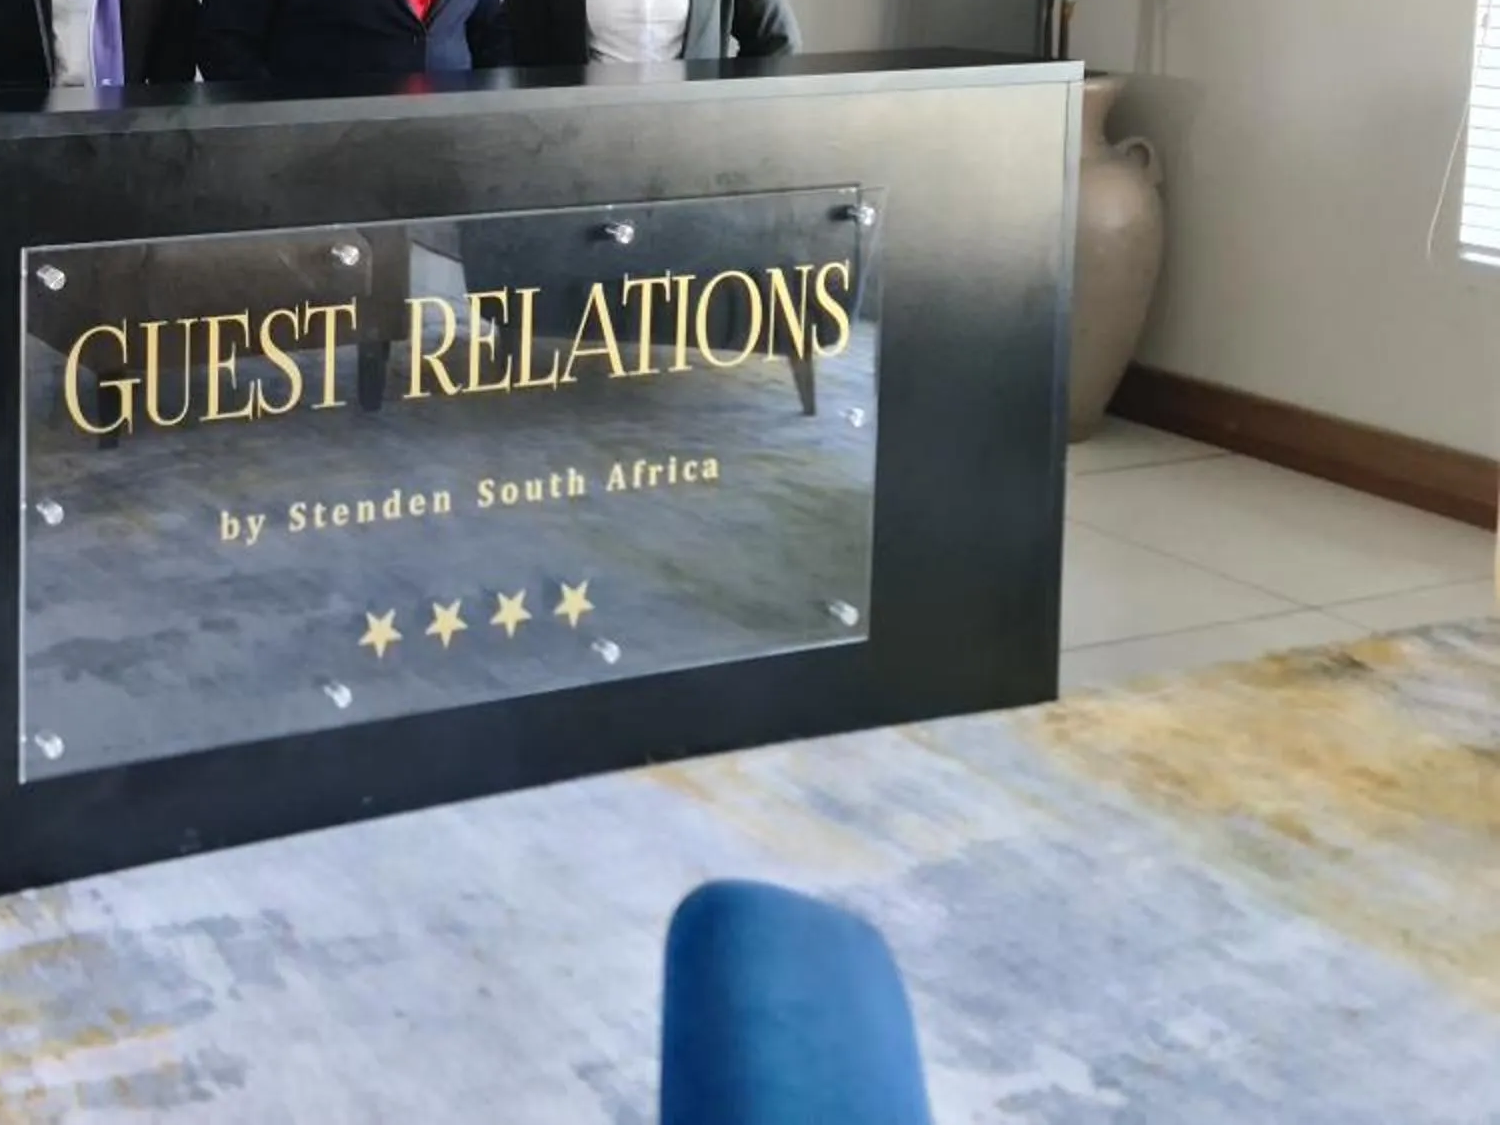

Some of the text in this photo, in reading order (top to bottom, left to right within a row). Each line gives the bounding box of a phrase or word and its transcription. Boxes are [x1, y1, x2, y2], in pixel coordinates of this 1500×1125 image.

[64, 259, 850, 435] GUEST RELATIONS
[220, 455, 720, 546] by Stenden South Africa
